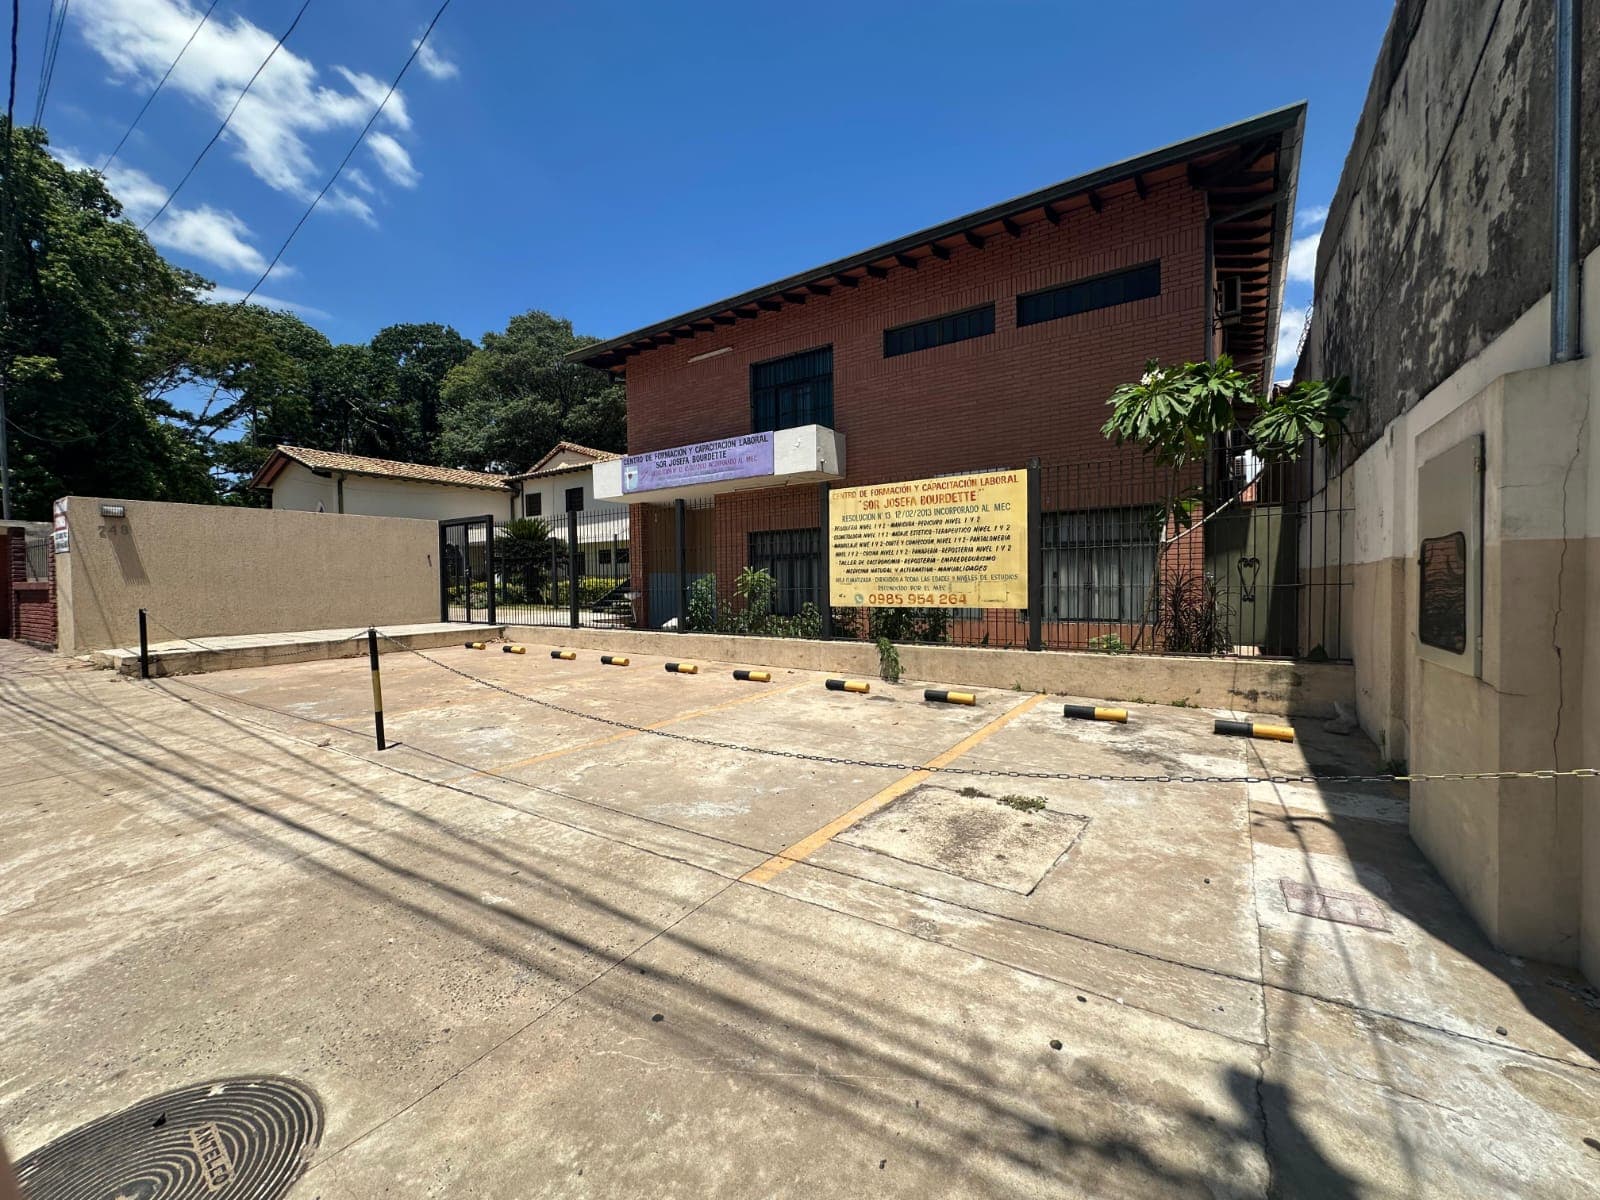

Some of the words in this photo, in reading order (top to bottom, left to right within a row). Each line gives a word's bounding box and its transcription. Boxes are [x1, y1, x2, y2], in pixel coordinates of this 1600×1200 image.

[624, 456, 643, 465] CENTRO
[739, 434, 768, 446] LABORAL
[656, 460, 667, 469] SOR
[669, 456, 689, 467] JOSEFA
[692, 450, 726, 463] BOURDETTE
[833, 491, 856, 500] CENTRO
[860, 489, 867, 497] DE
[871, 484, 911, 496] FORMACIÓN
[922, 477, 977, 491] CAPACITACIÓN
[981, 475, 1019, 486] LABORAL
[884, 497, 917, 508] JOSEFA
[895, 508, 932, 518] 12/02/2013
[934, 505, 979, 515] INCORPORADO
[982, 503, 990, 512] AL
[994, 502, 1010, 511] MEC
[991, 573, 1018, 581] ESTUDIOS
[868, 593, 903, 604] 0985
[908, 593, 934, 604] 954
[939, 593, 967, 605] 264
